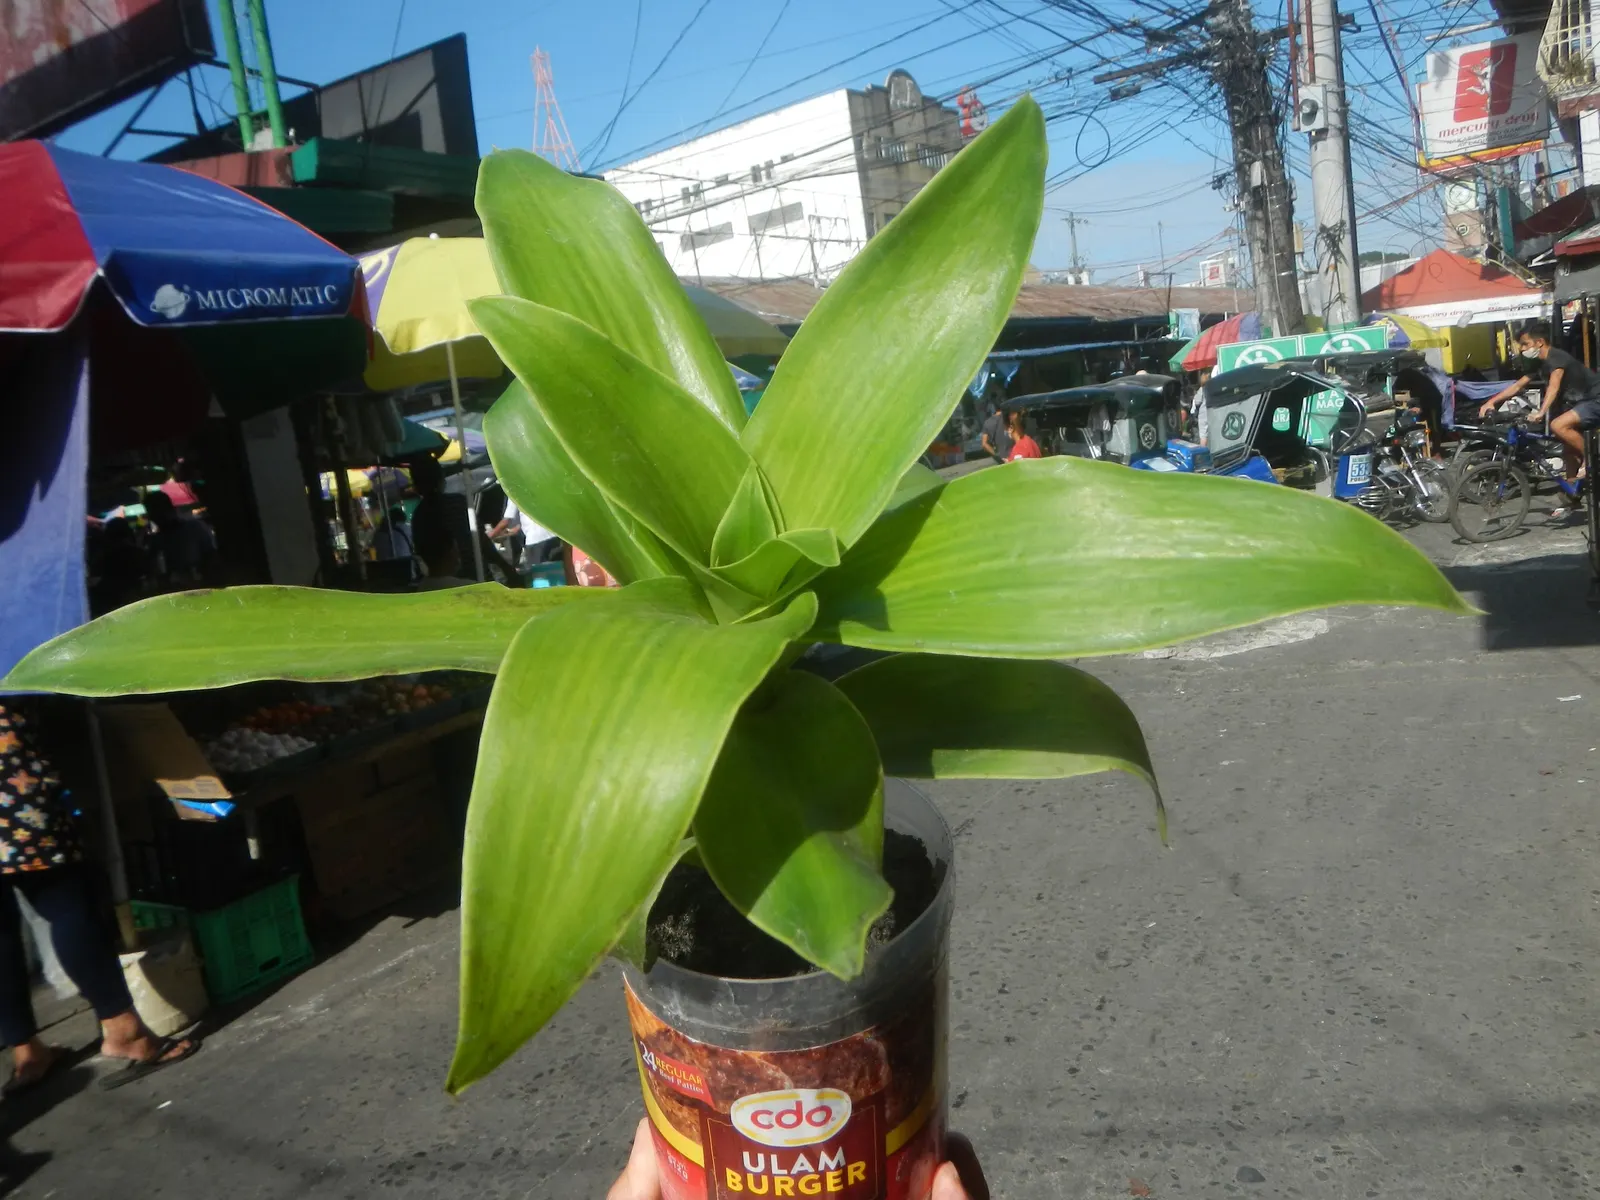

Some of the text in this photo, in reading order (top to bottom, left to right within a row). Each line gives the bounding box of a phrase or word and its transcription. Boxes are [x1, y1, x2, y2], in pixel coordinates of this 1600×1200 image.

[1438, 119, 1500, 138] mercury
[1505, 111, 1540, 126] drug
[195, 284, 338, 310] MICROMATIC
[640, 1041, 703, 1086] 24 REGULAR
[659, 1068, 704, 1094] Beef Patties
[751, 1100, 832, 1129] cdo
[742, 1146, 846, 1174] ULAM
[726, 1161, 867, 1197] BURGER
